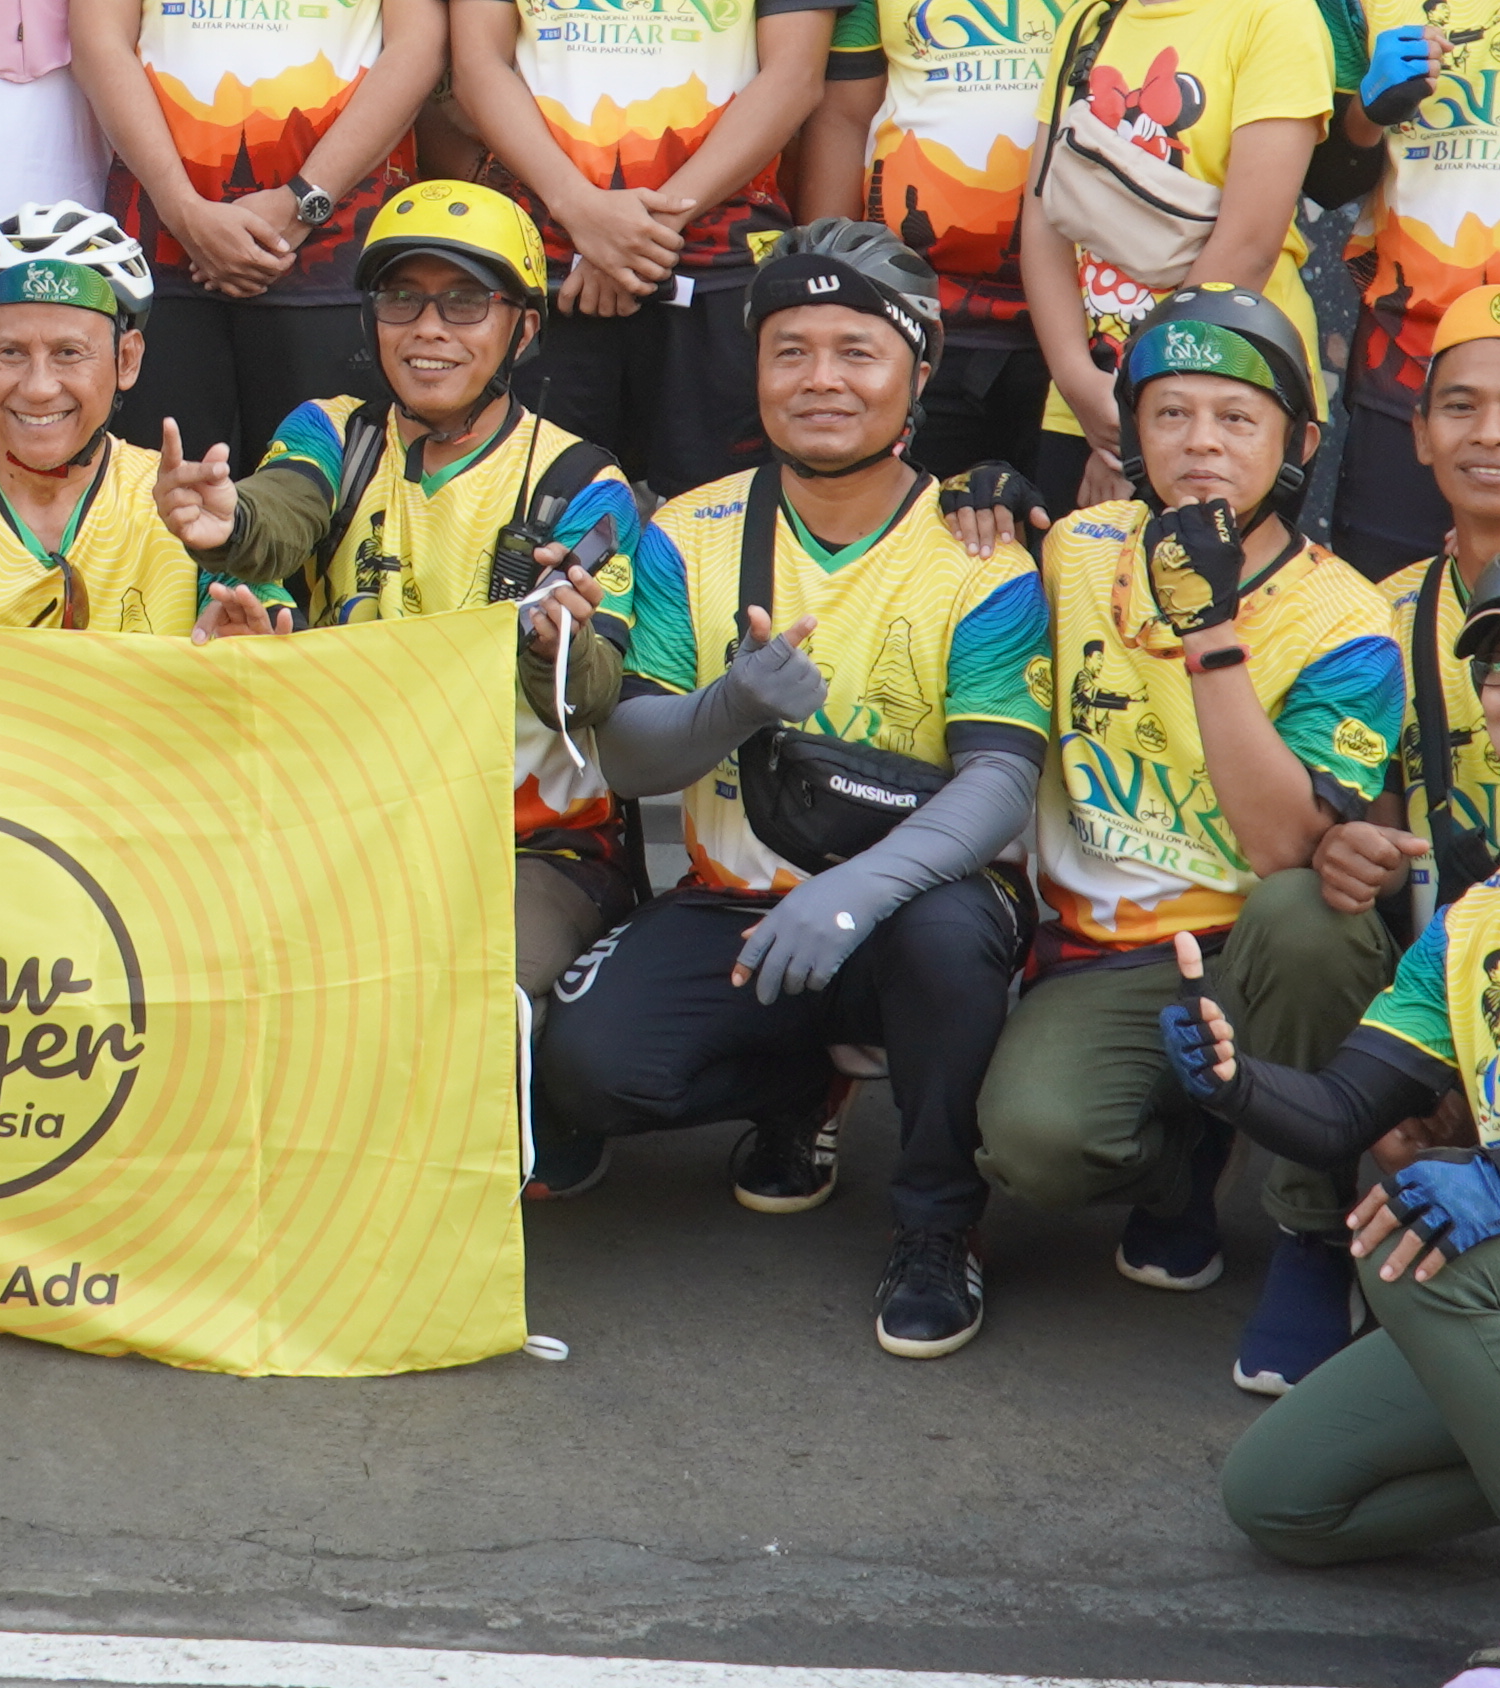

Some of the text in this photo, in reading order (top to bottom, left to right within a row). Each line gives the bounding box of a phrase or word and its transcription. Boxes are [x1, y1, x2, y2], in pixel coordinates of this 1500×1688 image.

[564, 21, 664, 46] BLITAR
[951, 57, 1046, 84] BLITA
[829, 775, 918, 809] QUIKSILVER
